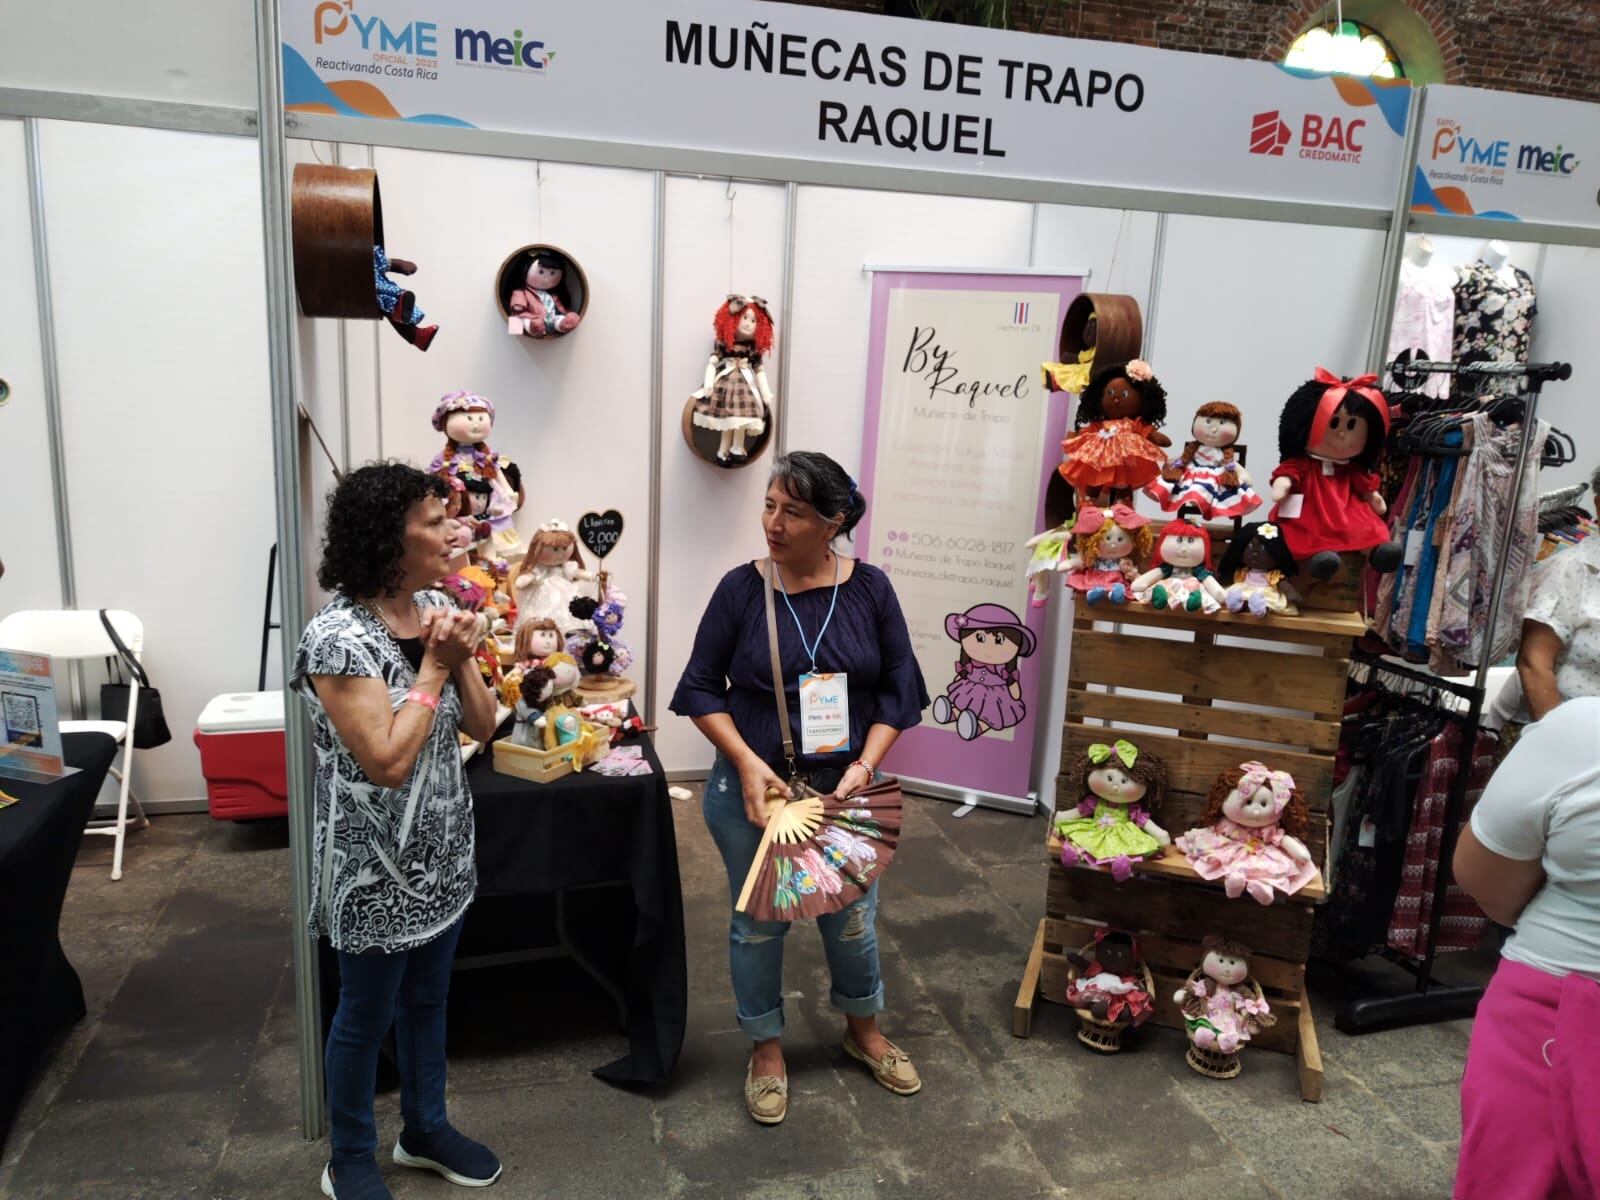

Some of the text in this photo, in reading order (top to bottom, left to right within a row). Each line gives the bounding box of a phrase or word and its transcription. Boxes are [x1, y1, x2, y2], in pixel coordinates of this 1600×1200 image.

[314, 1, 438, 57] PYME
[455, 28, 545, 69] meic
[316, 57, 382, 75] Reactivando
[384, 64, 414, 78] Costa
[416, 66, 438, 80] Rica
[373, 53, 409, 65] OFICIAL
[665, 18, 1145, 113] MUÑECAS DE TRAPO
[817, 100, 1006, 158] RAQUEL
[1300, 112, 1366, 153] BAC
[1432, 127, 1510, 168] PYME
[1299, 148, 1362, 164] CREDOMATIC
[1517, 144, 1575, 174] meic
[903, 326, 957, 373] By
[924, 367, 1029, 408] Raquel
[895, 548, 1016, 571] Muñecas de Trapo Raquel
[912, 532, 1016, 555] 506 6028-1817
